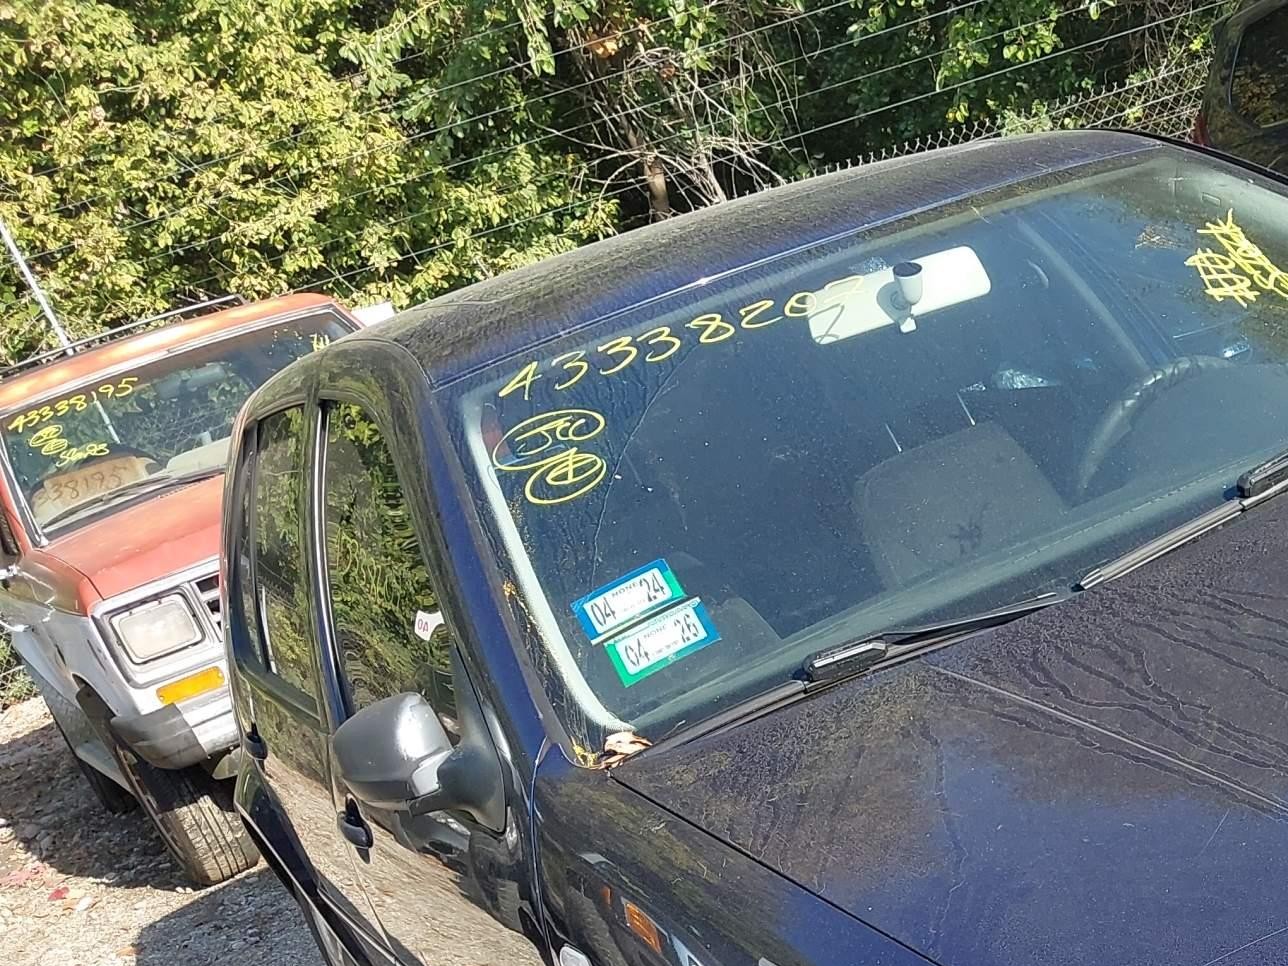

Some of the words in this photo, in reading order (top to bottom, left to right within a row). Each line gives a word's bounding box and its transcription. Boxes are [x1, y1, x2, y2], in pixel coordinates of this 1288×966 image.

[498, 274, 866, 402] 43338207
[8, 377, 138, 433] 43338195
[590, 596, 617, 627] 04
[639, 573, 666, 602] 24
[624, 638, 650, 666] 04
